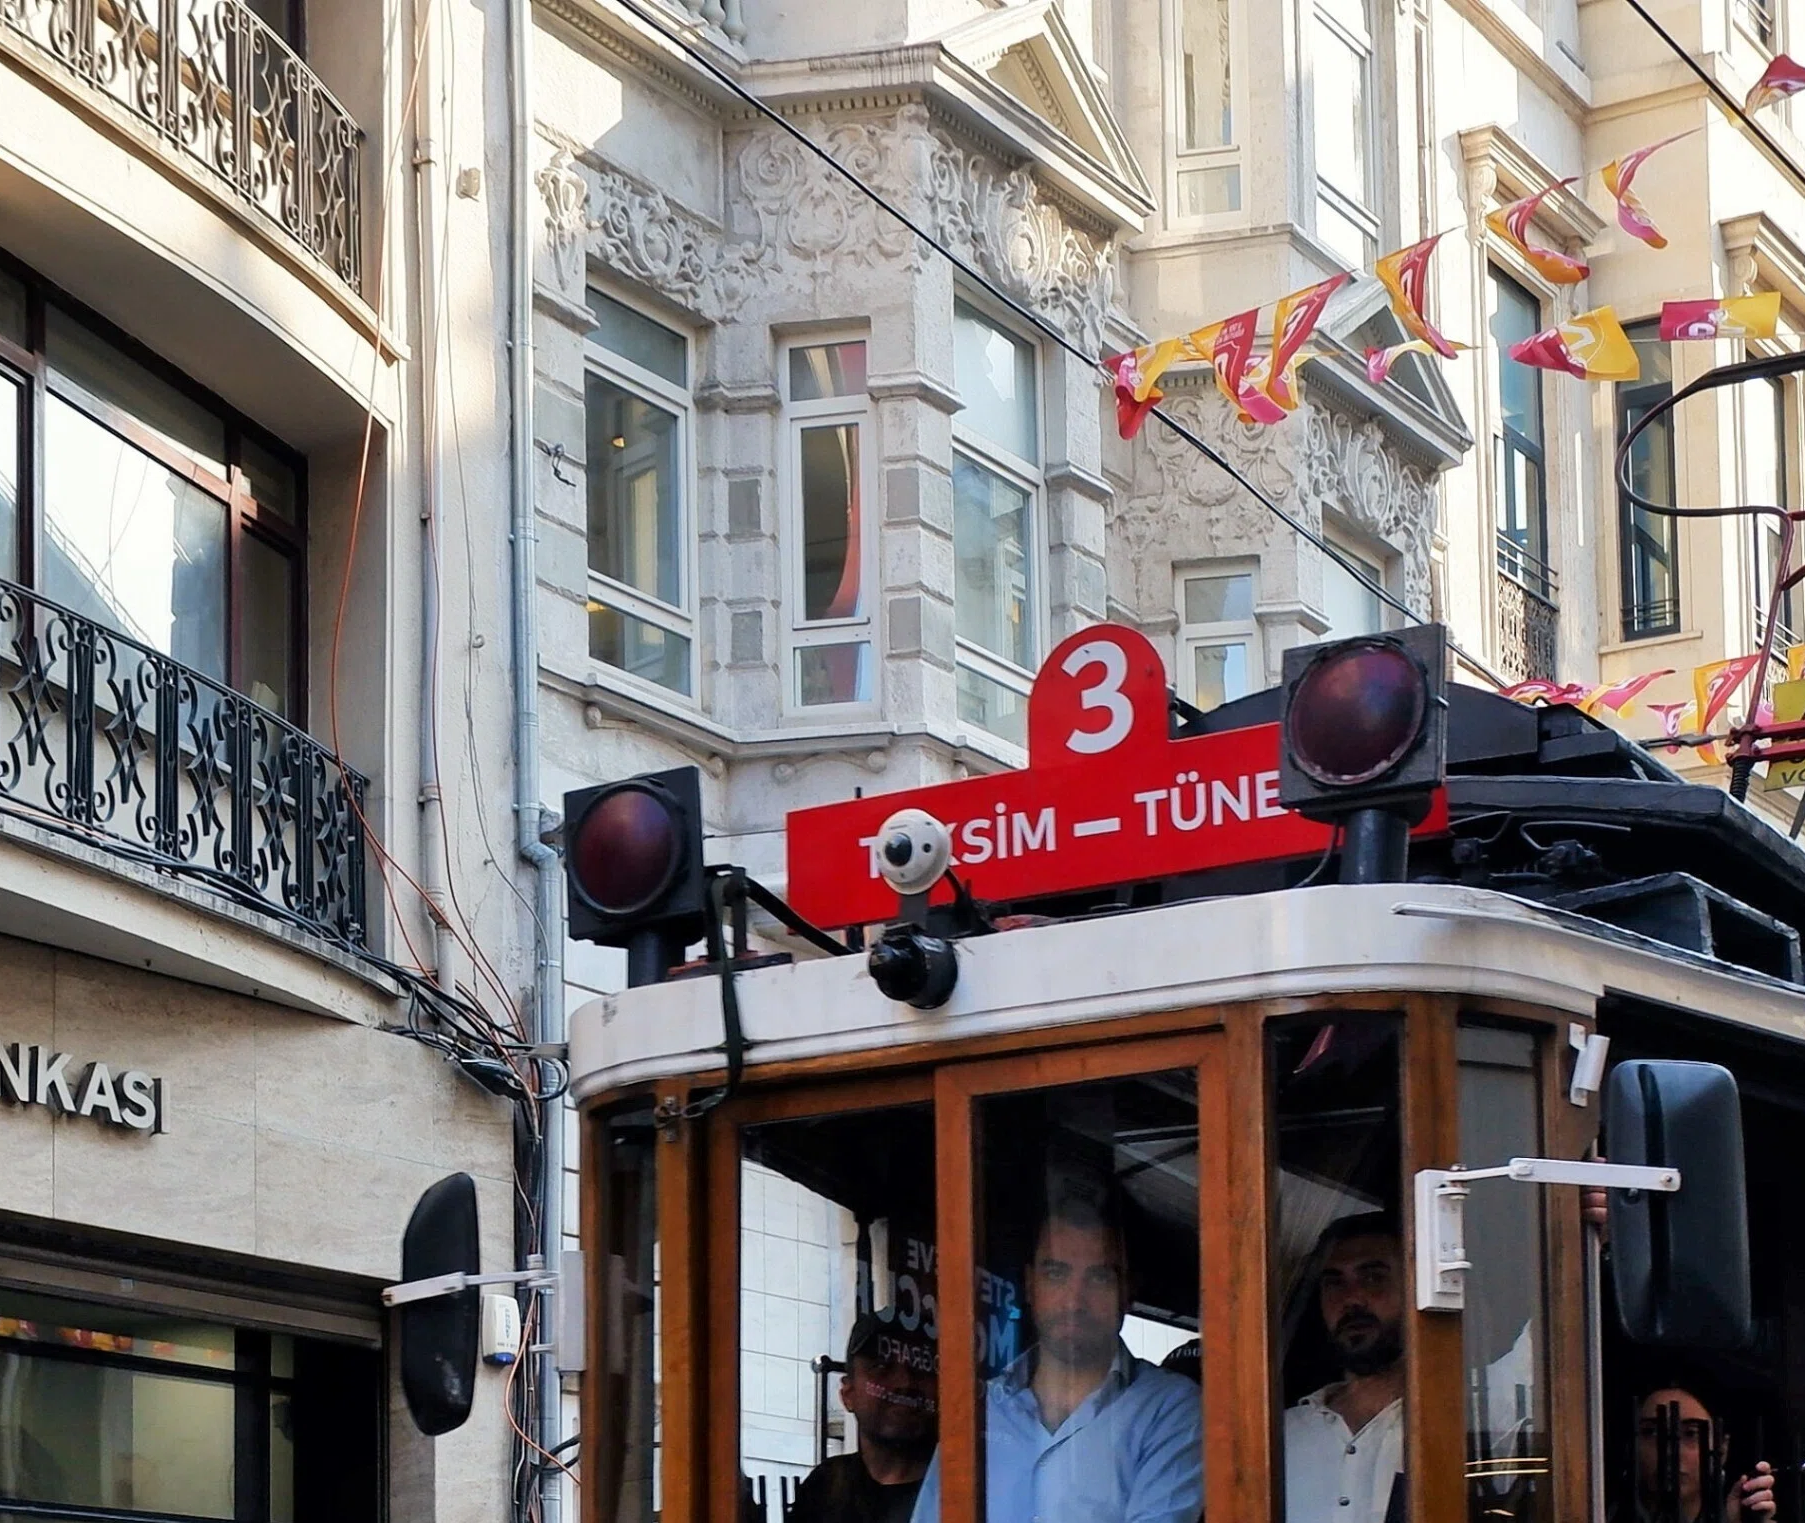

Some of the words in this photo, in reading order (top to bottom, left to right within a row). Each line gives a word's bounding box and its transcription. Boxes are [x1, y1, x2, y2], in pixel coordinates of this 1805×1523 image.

[1061, 640, 1134, 754] 3
[859, 801, 1057, 880] TSİM
[1133, 771, 1300, 836] TÜNE
